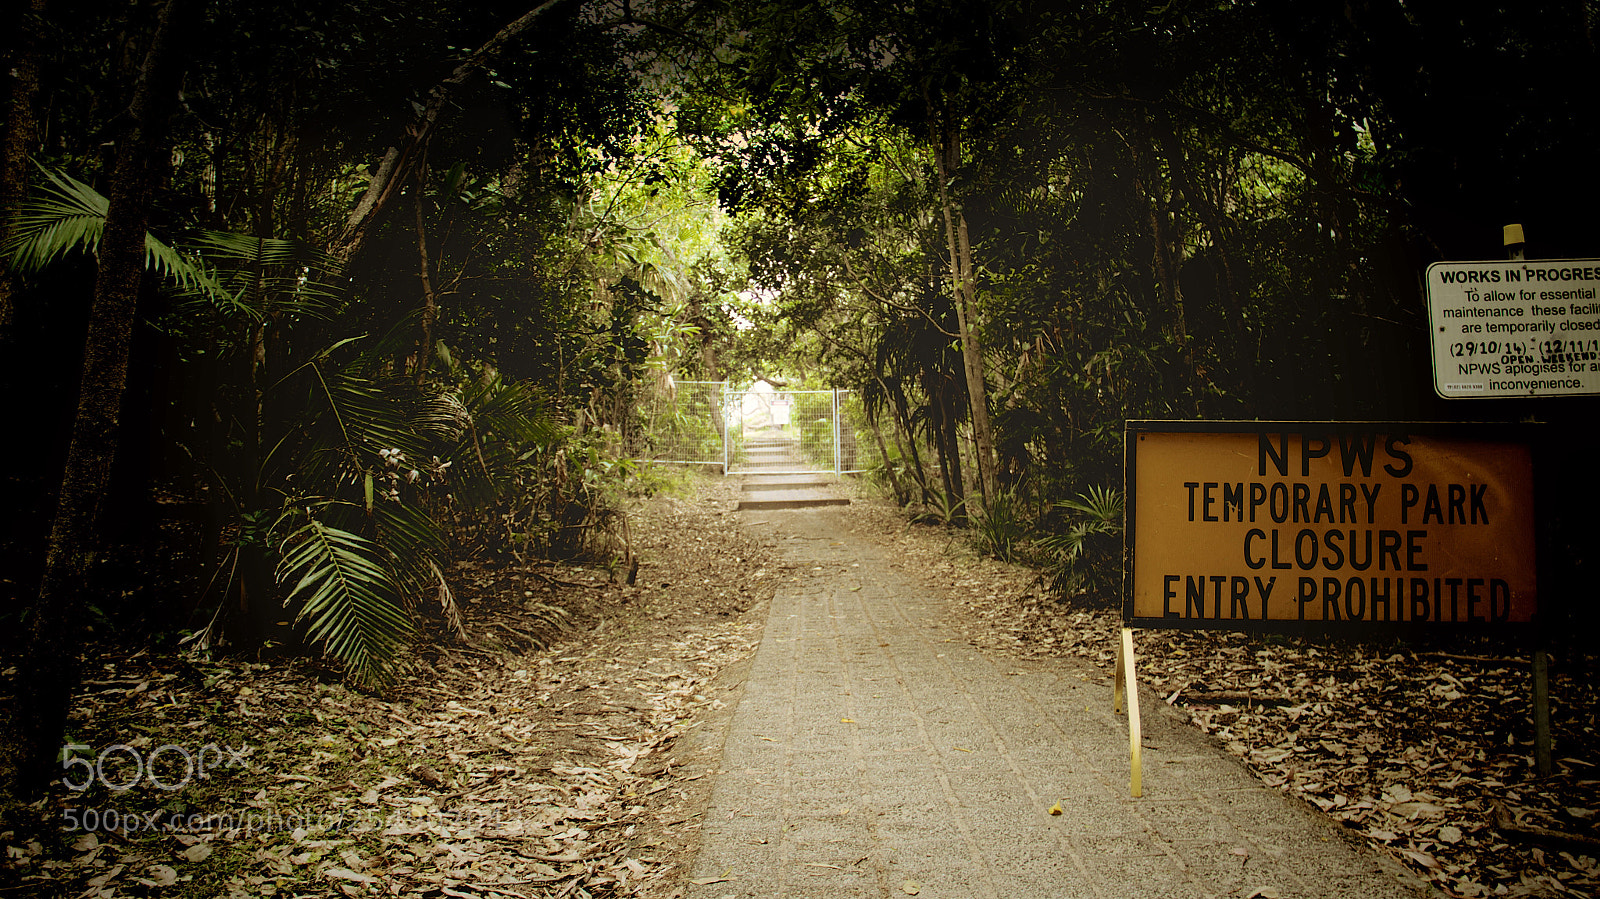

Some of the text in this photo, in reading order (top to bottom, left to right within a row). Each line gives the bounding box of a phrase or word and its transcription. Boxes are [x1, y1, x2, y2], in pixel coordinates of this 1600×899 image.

[1440, 270, 1501, 284] WORKS
[1505, 269, 1521, 282] IN
[1465, 288, 1596, 302] To allow for essential
[1443, 306, 1524, 318] maintenance
[1531, 305, 1566, 316] these
[1461, 319, 1600, 334] are temporarily closed
[1450, 341, 1527, 358] (29/10/14)
[1501, 355, 1535, 365] OPEN
[1458, 363, 1502, 375] NPWS
[1568, 363, 1586, 373] for
[1489, 379, 1585, 391] inconvenience.
[1257, 432, 1414, 478] NPWS
[1184, 482, 1490, 525] TEMPORARY PARK
[1244, 529, 1428, 571] CLOSURE
[1163, 575, 1511, 623] ENTRY PROHIBITED
